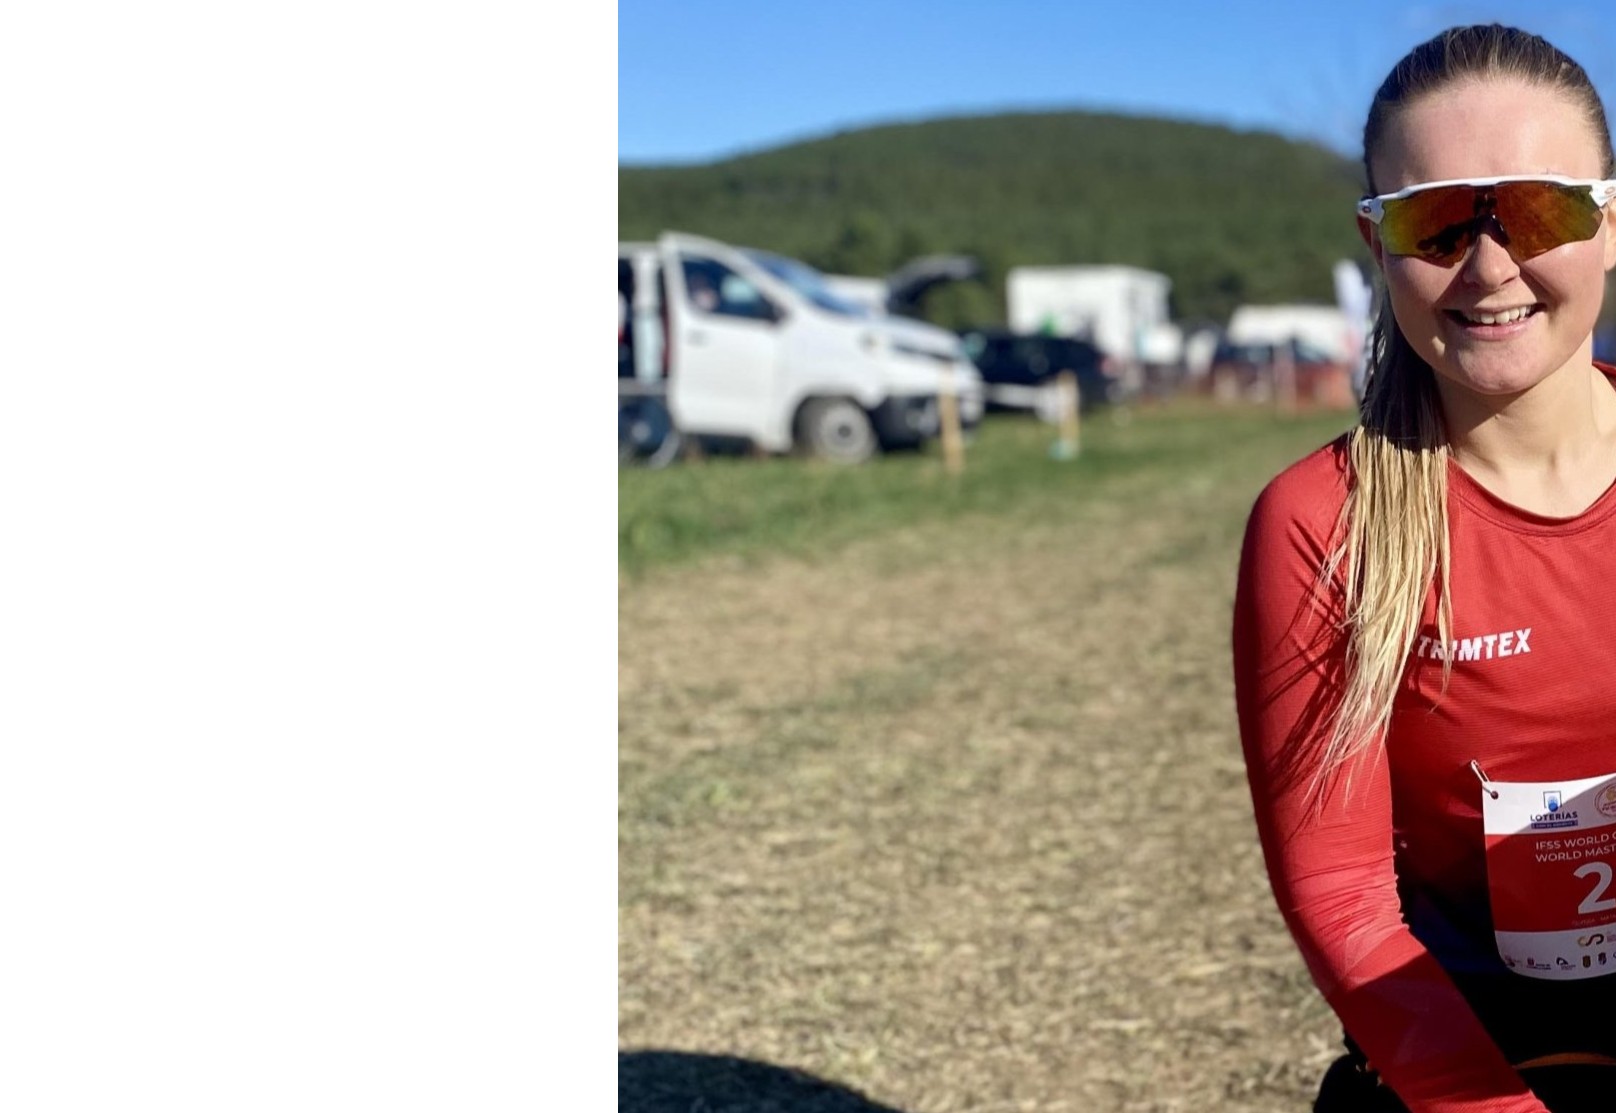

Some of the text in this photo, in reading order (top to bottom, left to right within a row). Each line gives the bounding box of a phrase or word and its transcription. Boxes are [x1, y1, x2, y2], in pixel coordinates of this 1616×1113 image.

[1417, 628, 1532, 662] TRIMTEX
[1535, 839, 1562, 850] IFSS
[1564, 833, 1610, 848] WORLD
[1535, 850, 1582, 863] WORLD
